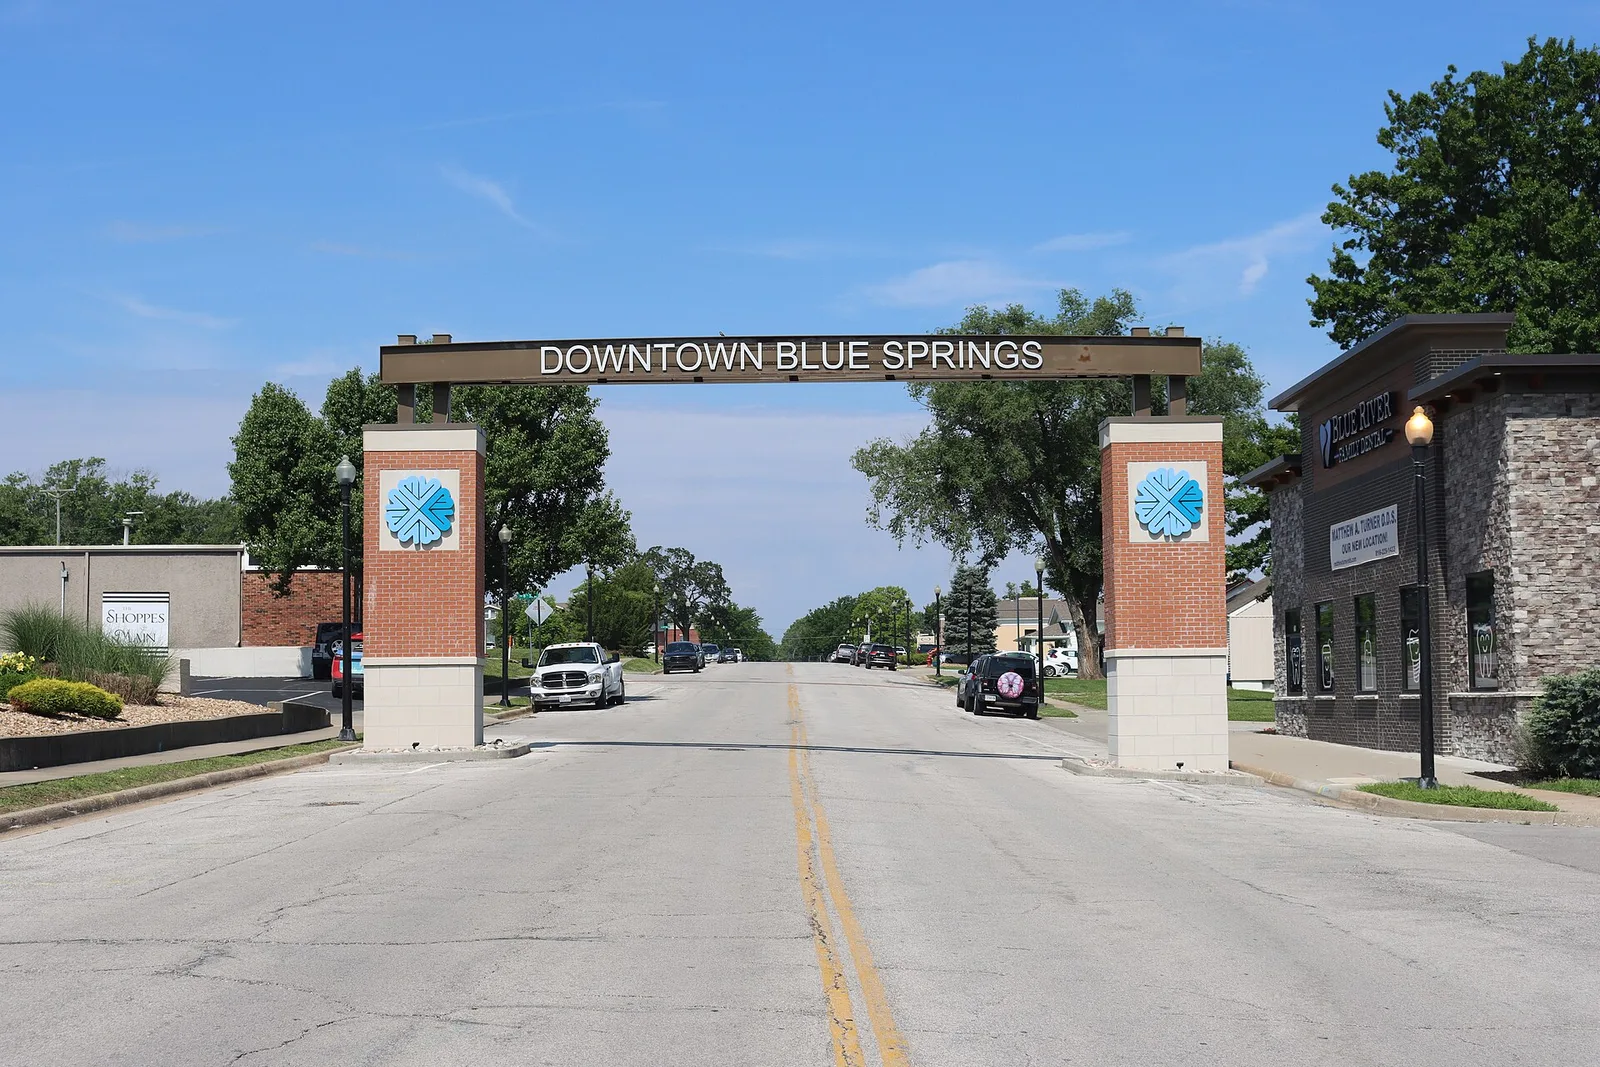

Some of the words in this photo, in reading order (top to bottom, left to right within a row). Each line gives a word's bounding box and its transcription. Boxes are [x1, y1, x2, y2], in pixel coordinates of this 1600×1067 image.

[540, 342, 763, 374] DOWNTOWN
[776, 341, 870, 370] BLUE
[882, 340, 1044, 370] SPRINGS
[1332, 408, 1358, 443] BLUE
[1359, 391, 1392, 431] RIVER
[1338, 439, 1361, 463] FAMILY
[1360, 428, 1386, 454] DENTAL
[1332, 524, 1354, 542] MATTHEW
[1360, 514, 1381, 533] TURNER
[1341, 542, 1352, 554] OUR
[1351, 540, 1363, 552] NEW
[106, 609, 165, 624] SHOPPES
